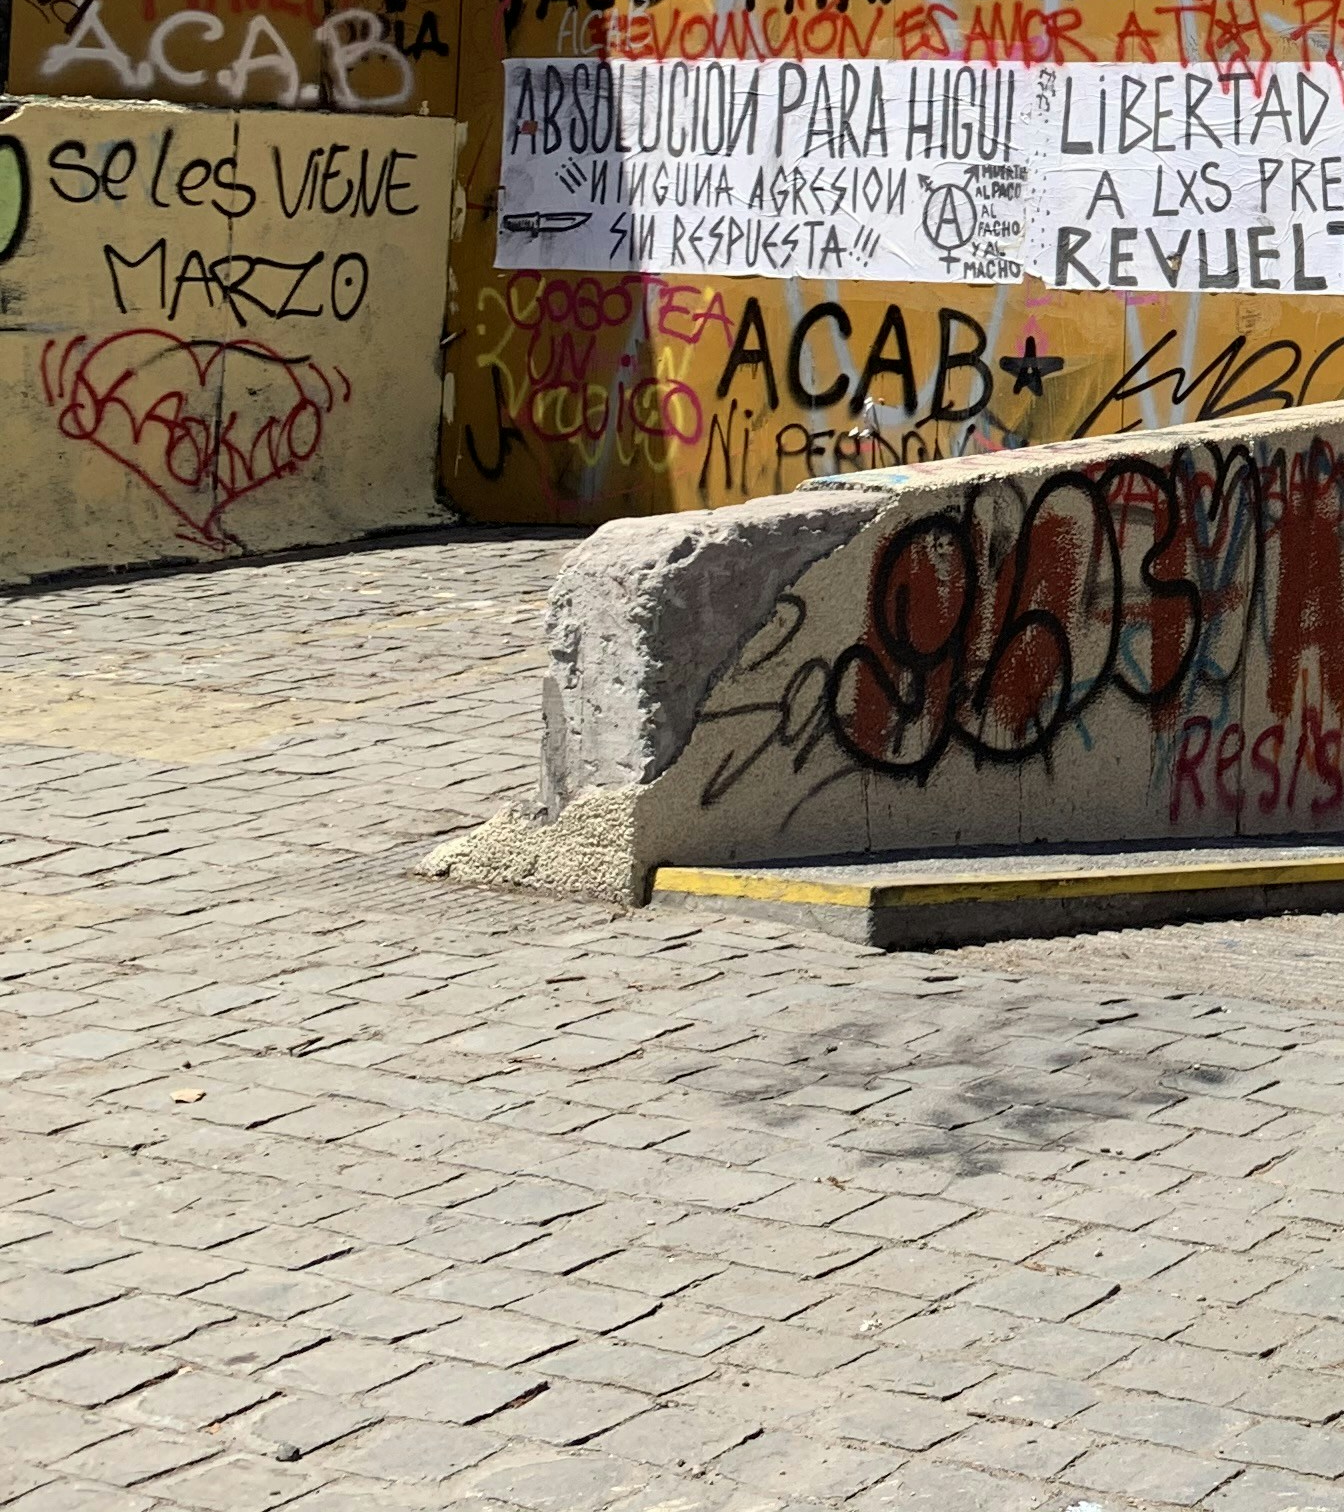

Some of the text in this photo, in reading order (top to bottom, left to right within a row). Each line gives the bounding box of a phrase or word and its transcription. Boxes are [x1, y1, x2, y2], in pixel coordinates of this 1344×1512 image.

[895, 2, 959, 60] ES
[776, 66, 887, 160] PARA
[906, 65, 1015, 162] HIGUI
[748, 166, 907, 216] AGRESION
[980, 203, 997, 219] AL
[1086, 170, 1125, 221] A
[1153, 161, 1232, 217] LXS
[609, 214, 655, 262] SIN
[972, 240, 1006, 257] Y AL
[978, 220, 1021, 238] FACHO
[103, 238, 369, 327] MARZO
[963, 259, 1021, 280] MACHO
[717, 296, 993, 427] ACAB
